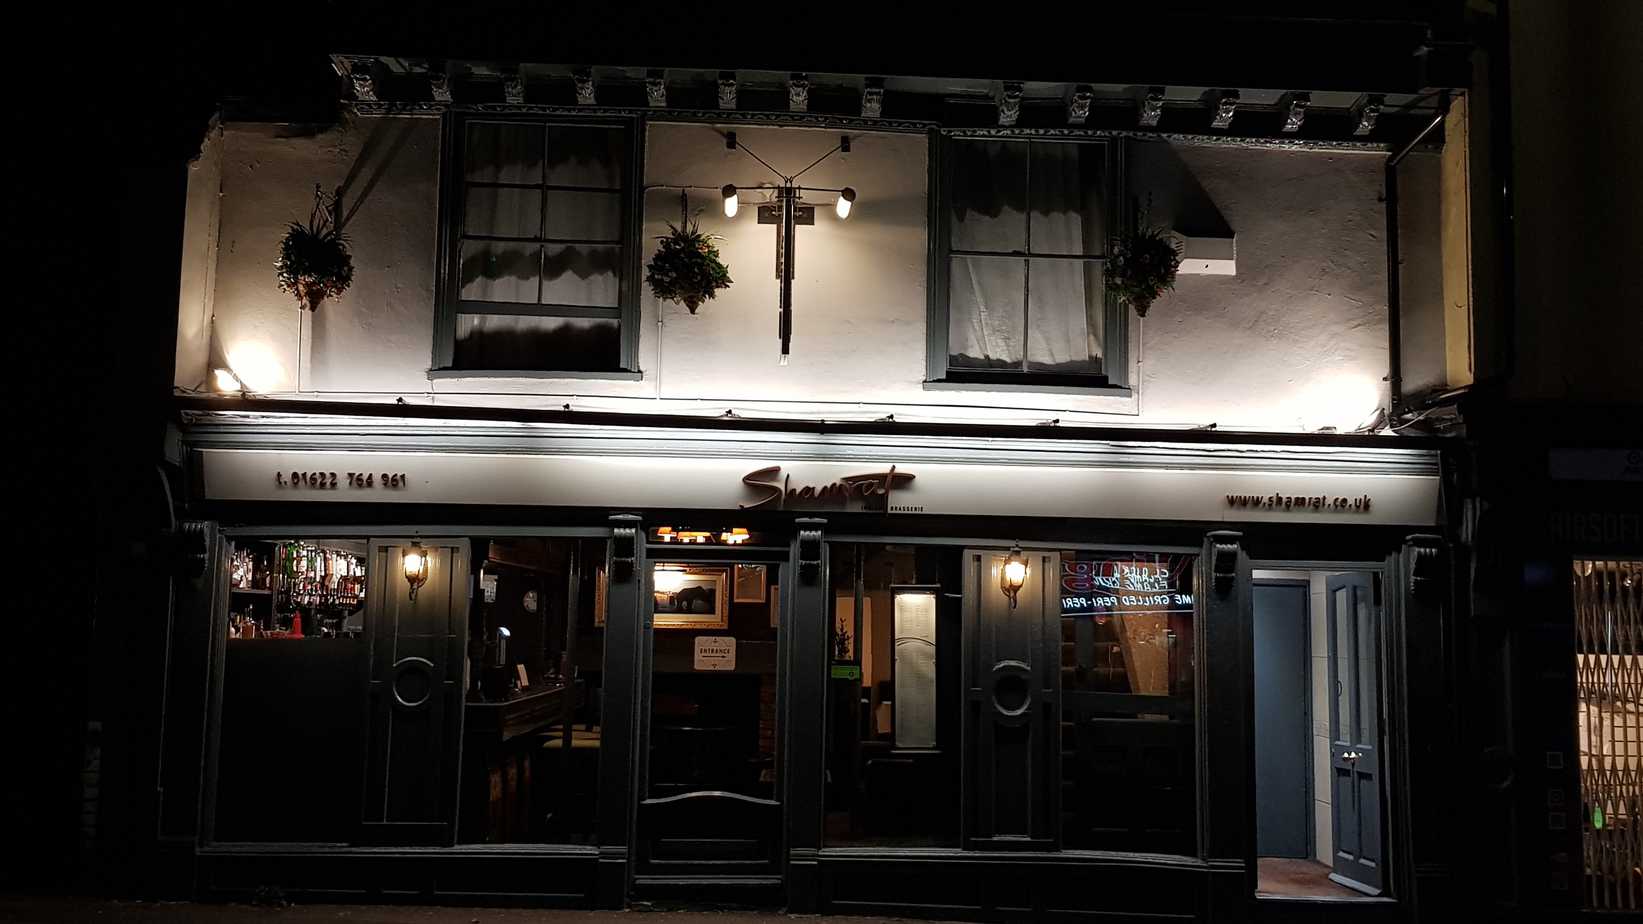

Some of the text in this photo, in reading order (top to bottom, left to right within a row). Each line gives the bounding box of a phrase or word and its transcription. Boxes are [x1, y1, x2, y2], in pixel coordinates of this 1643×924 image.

[291, 471, 337, 488] 01622
[347, 472, 373, 488] 764
[380, 473, 406, 488] 961
[738, 465, 916, 512] Shamrat
[1226, 492, 1371, 512] www.shamrat.co.uk
[699, 647, 730, 655] ENTRANCE
